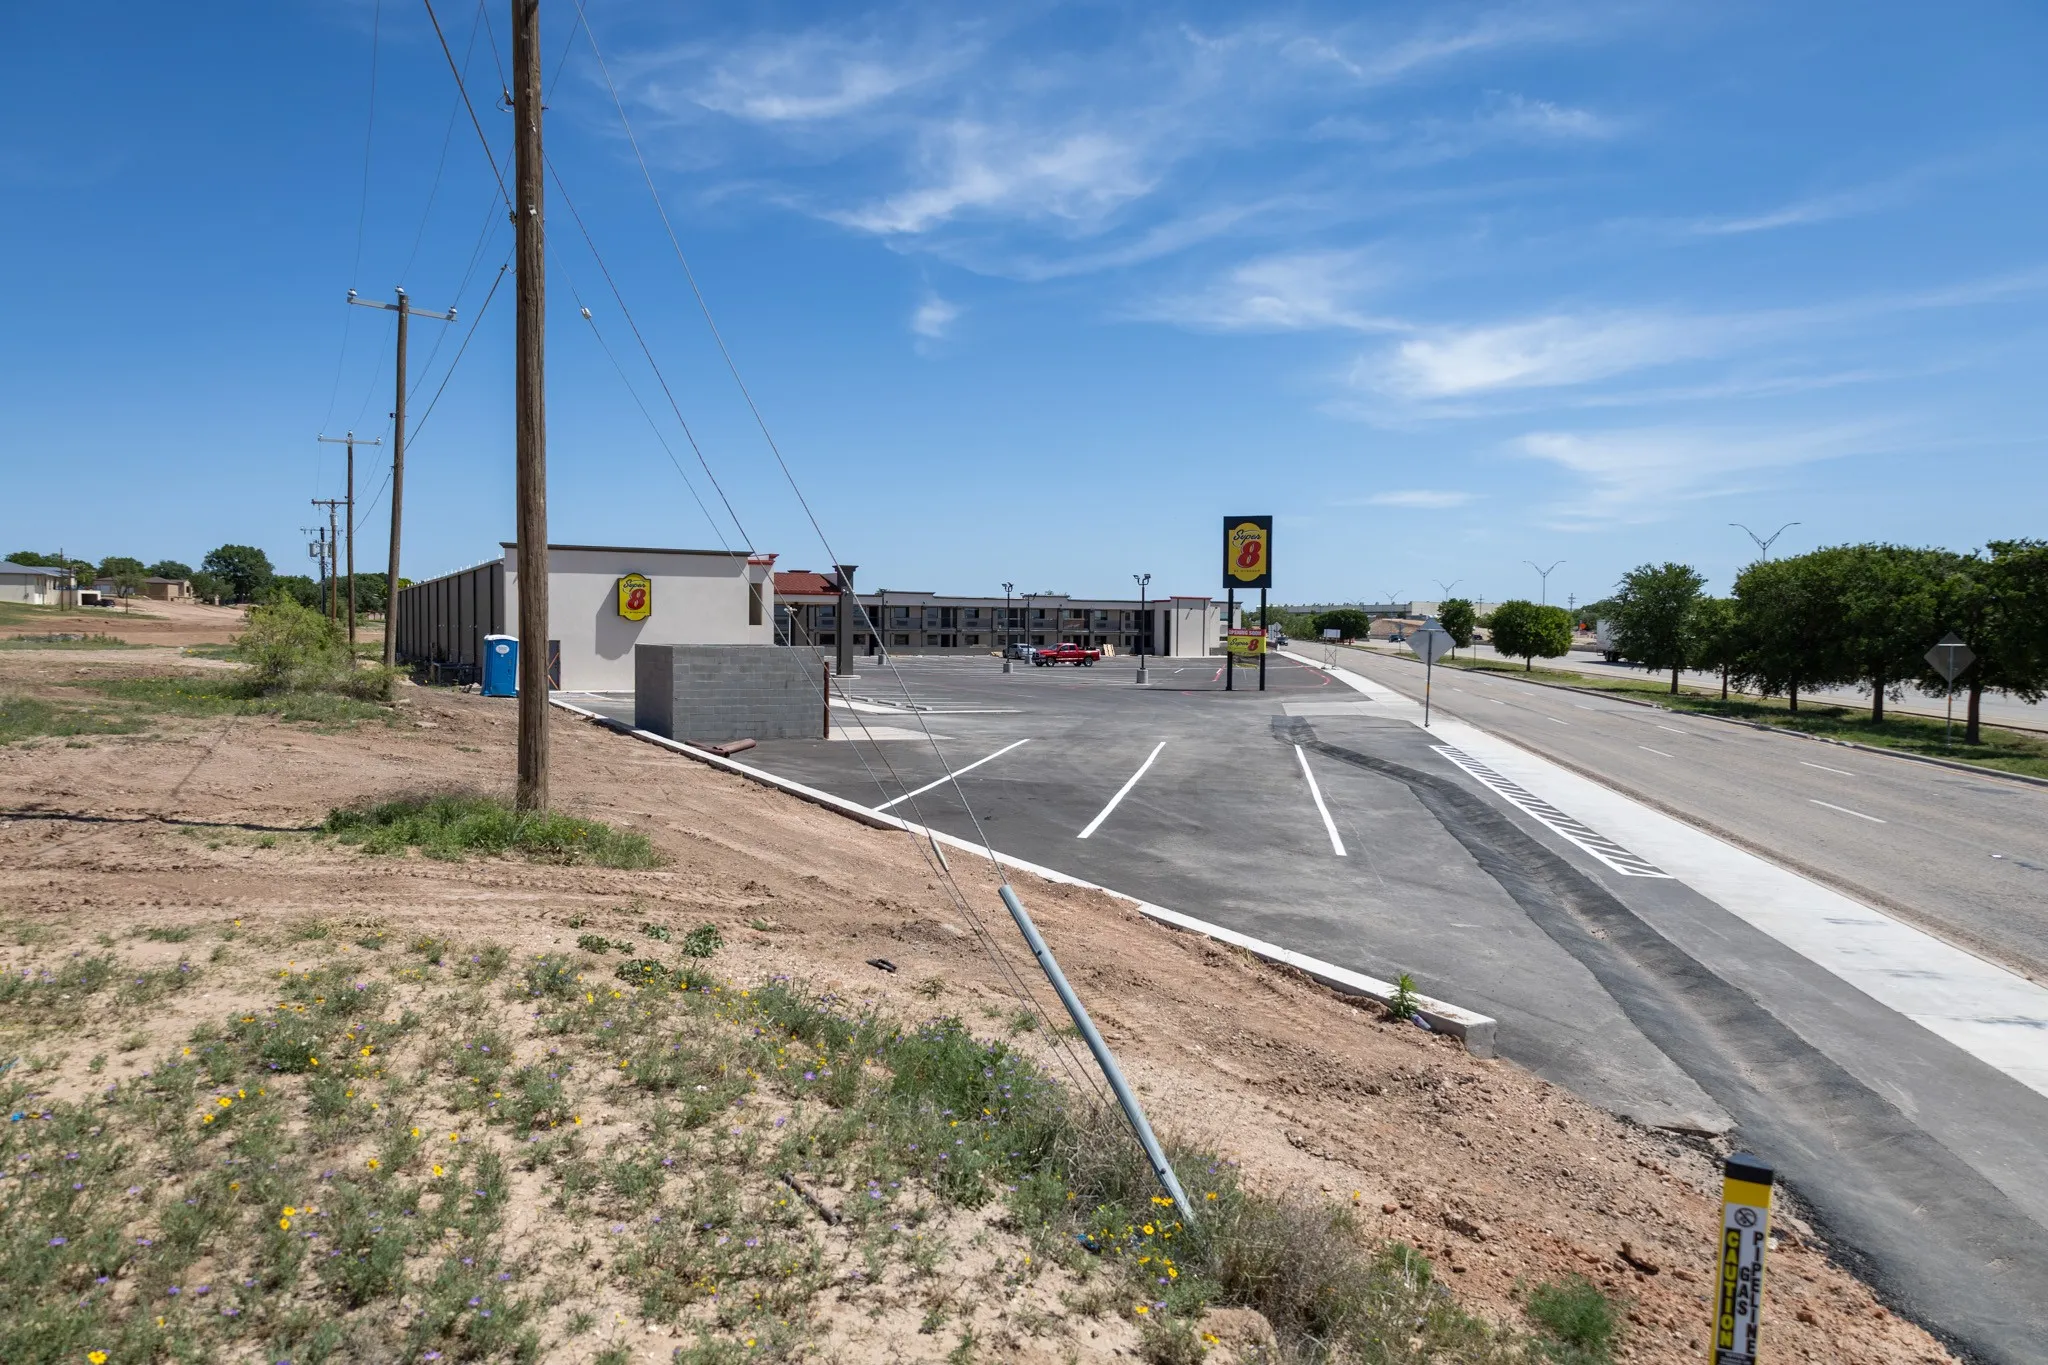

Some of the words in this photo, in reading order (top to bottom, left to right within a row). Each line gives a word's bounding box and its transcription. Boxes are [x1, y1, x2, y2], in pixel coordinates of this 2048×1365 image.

[1233, 529, 1262, 545] Super
[1236, 541, 1262, 568] 8
[623, 579, 646, 592] Super
[626, 589, 646, 610] 8
[1230, 638, 1248, 646] Super
[1247, 639, 1259, 651] 8
[1719, 1231, 1740, 1347] CAUTION
[1737, 1266, 1750, 1316] GAS
[1746, 1231, 1764, 1355] PIPELINE
